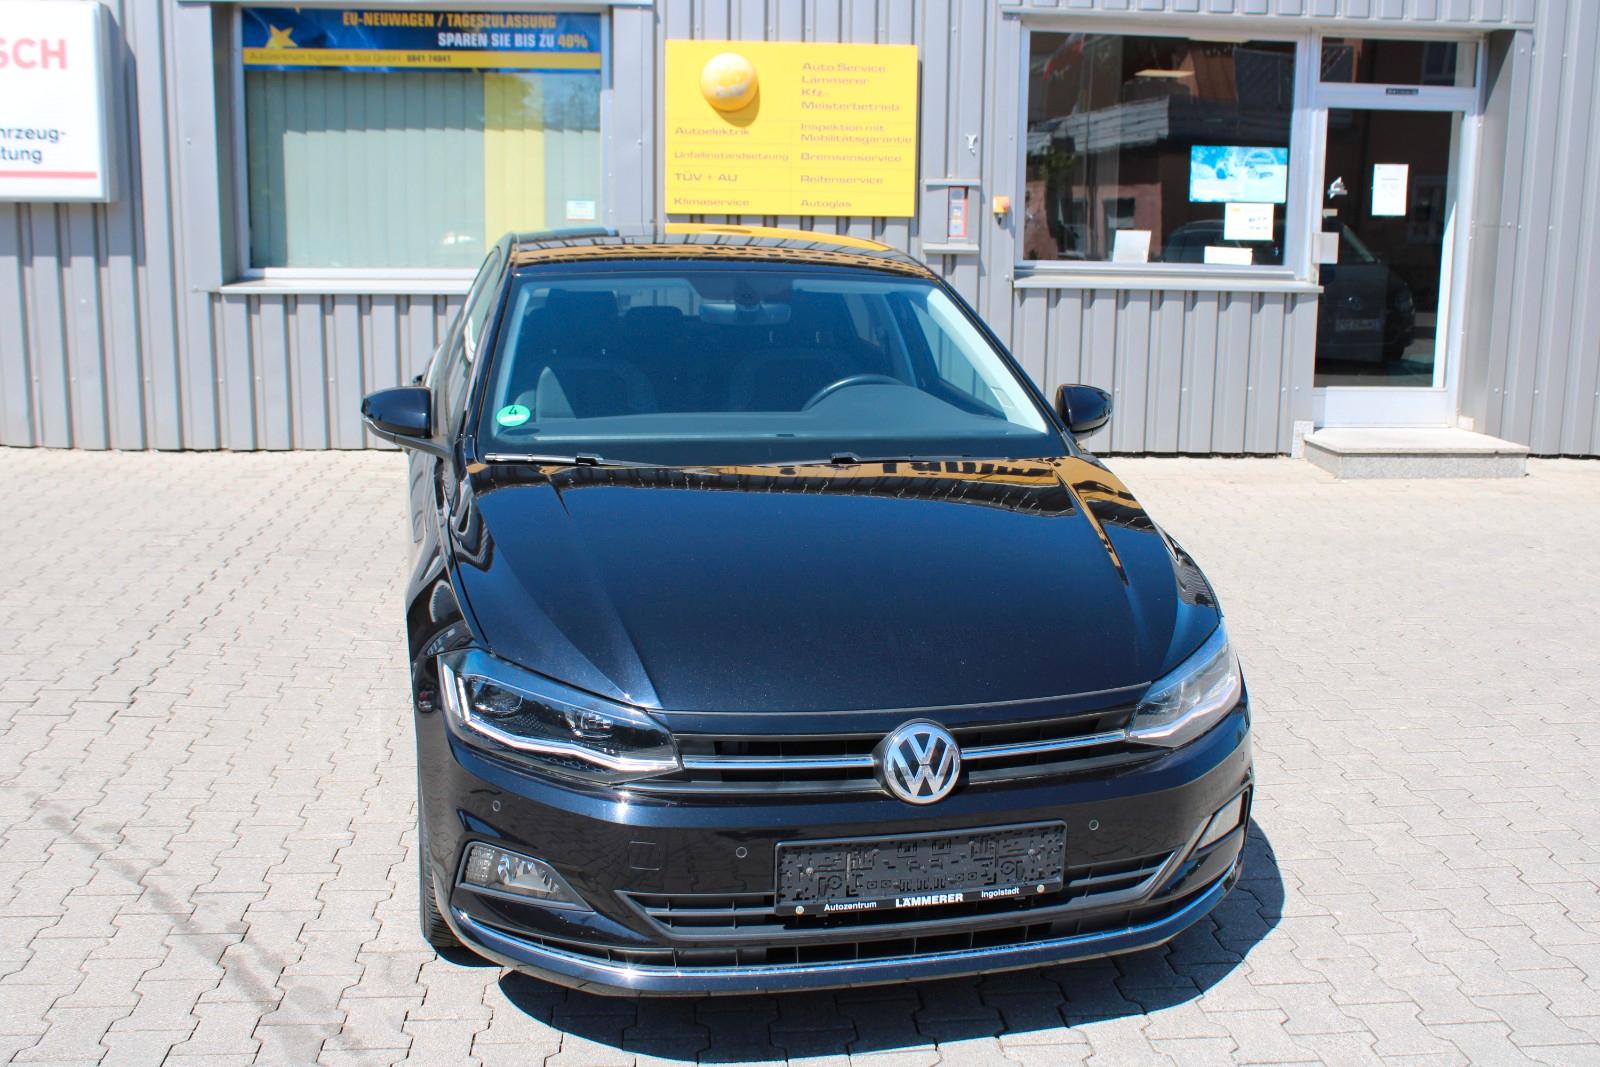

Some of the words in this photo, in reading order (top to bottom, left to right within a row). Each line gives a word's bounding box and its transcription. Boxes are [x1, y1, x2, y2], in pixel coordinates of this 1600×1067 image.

[342, 12, 434, 27] EU-NEUWAGEN
[446, 14, 557, 29] TAGESZULASSUNG
[438, 33, 488, 48] SPAREN
[491, 34, 511, 48] SIE
[514, 34, 535, 49] BIS
[538, 34, 554, 49] ZU
[557, 35, 588, 50] 40%
[674, 171, 703, 183] TÜV
[508, 406, 518, 415] 4
[823, 900, 877, 913] Autozentrum
[895, 893, 964, 908] LÄMMERER
[981, 886, 1020, 899] Ingolstadt
